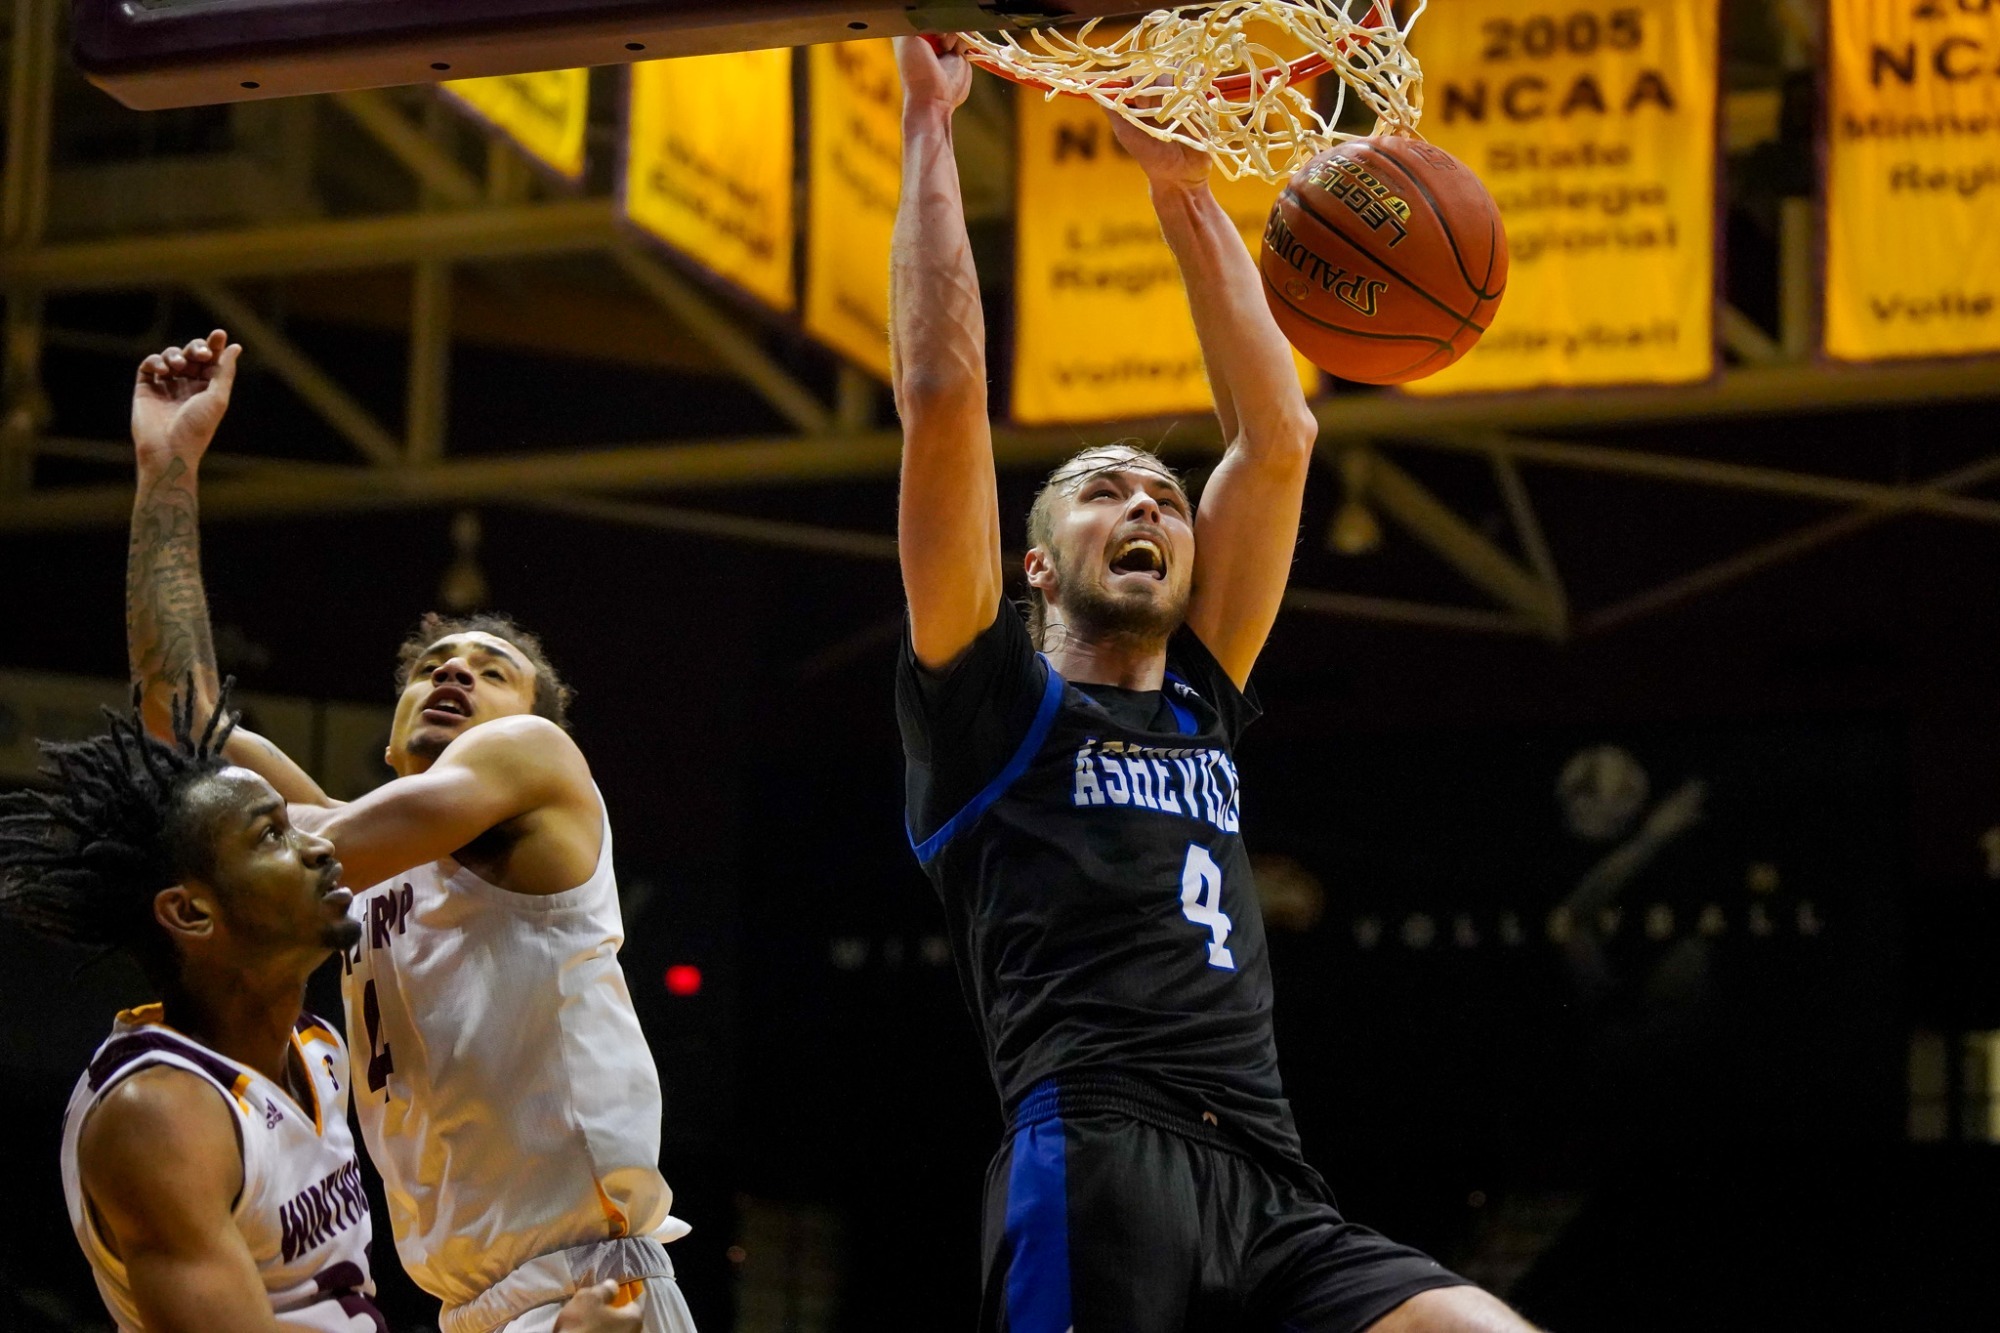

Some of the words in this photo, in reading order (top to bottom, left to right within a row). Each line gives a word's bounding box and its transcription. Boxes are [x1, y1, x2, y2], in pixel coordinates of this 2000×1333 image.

[1480, 7, 1644, 63] 2005
[1868, 36, 2000, 90] NC
[1440, 69, 1678, 127] NCAA
[1486, 142, 1632, 174] State
[1497, 185, 1667, 217] ollege
[1508, 217, 1679, 263] gional
[1868, 290, 1996, 324] Volle
[1478, 320, 1680, 362] lleyball
[1180, 843, 1237, 970] 4
